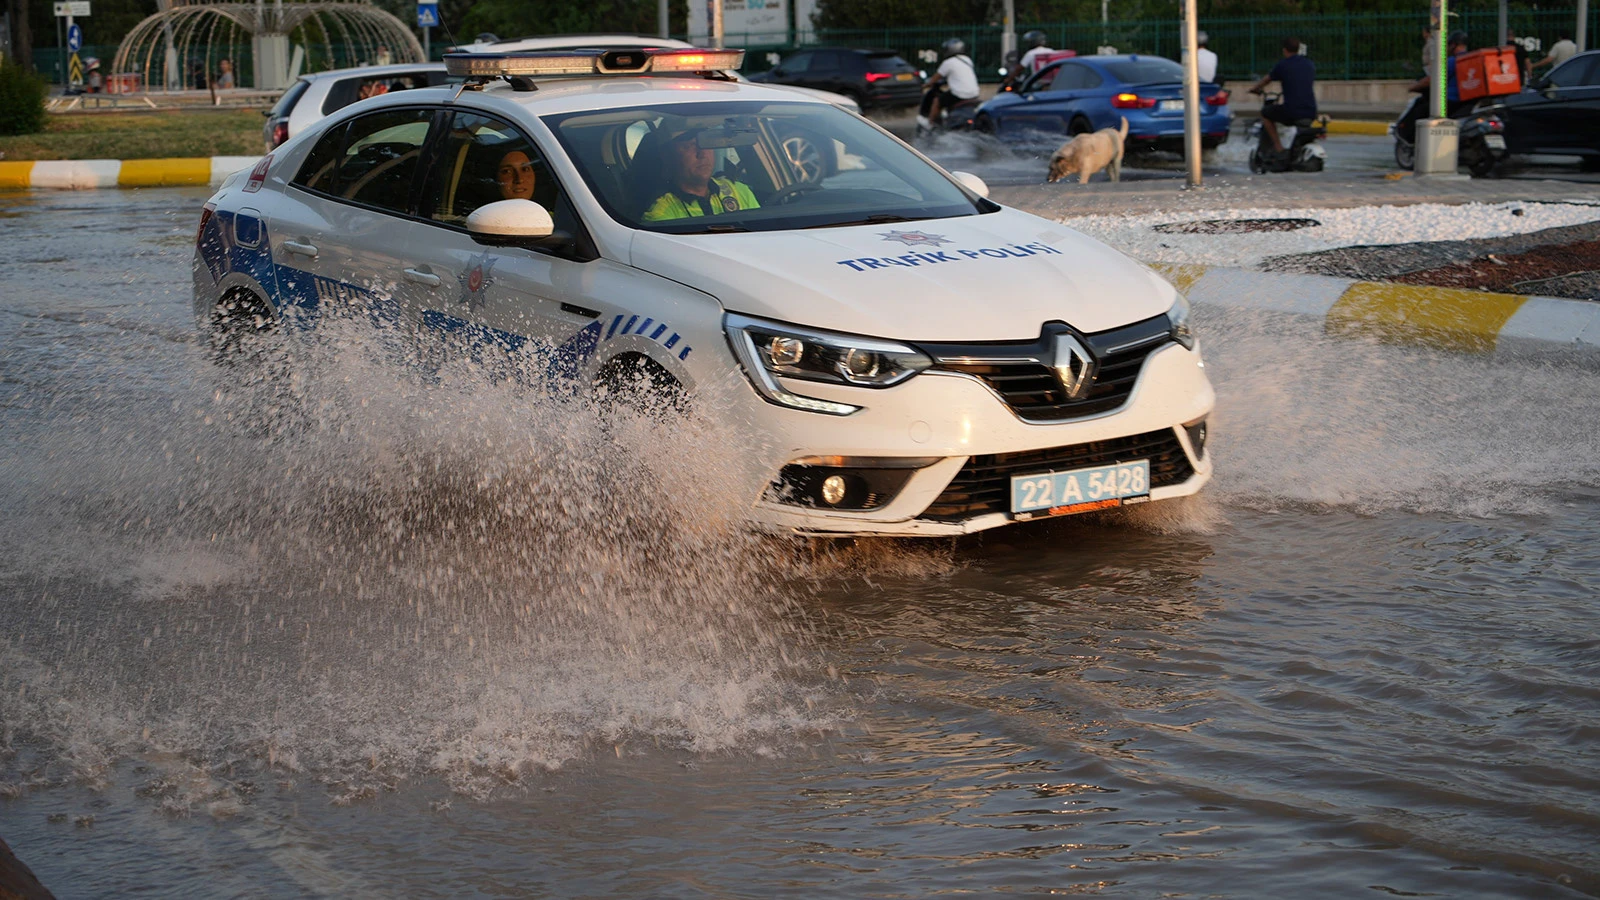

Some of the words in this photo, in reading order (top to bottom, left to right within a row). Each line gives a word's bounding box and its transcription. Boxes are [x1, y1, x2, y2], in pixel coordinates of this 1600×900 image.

[837, 251, 961, 272] TRAFİK
[1021, 479, 1052, 508] 22
[1061, 475, 1084, 503] A
[1088, 466, 1145, 499] 5428
